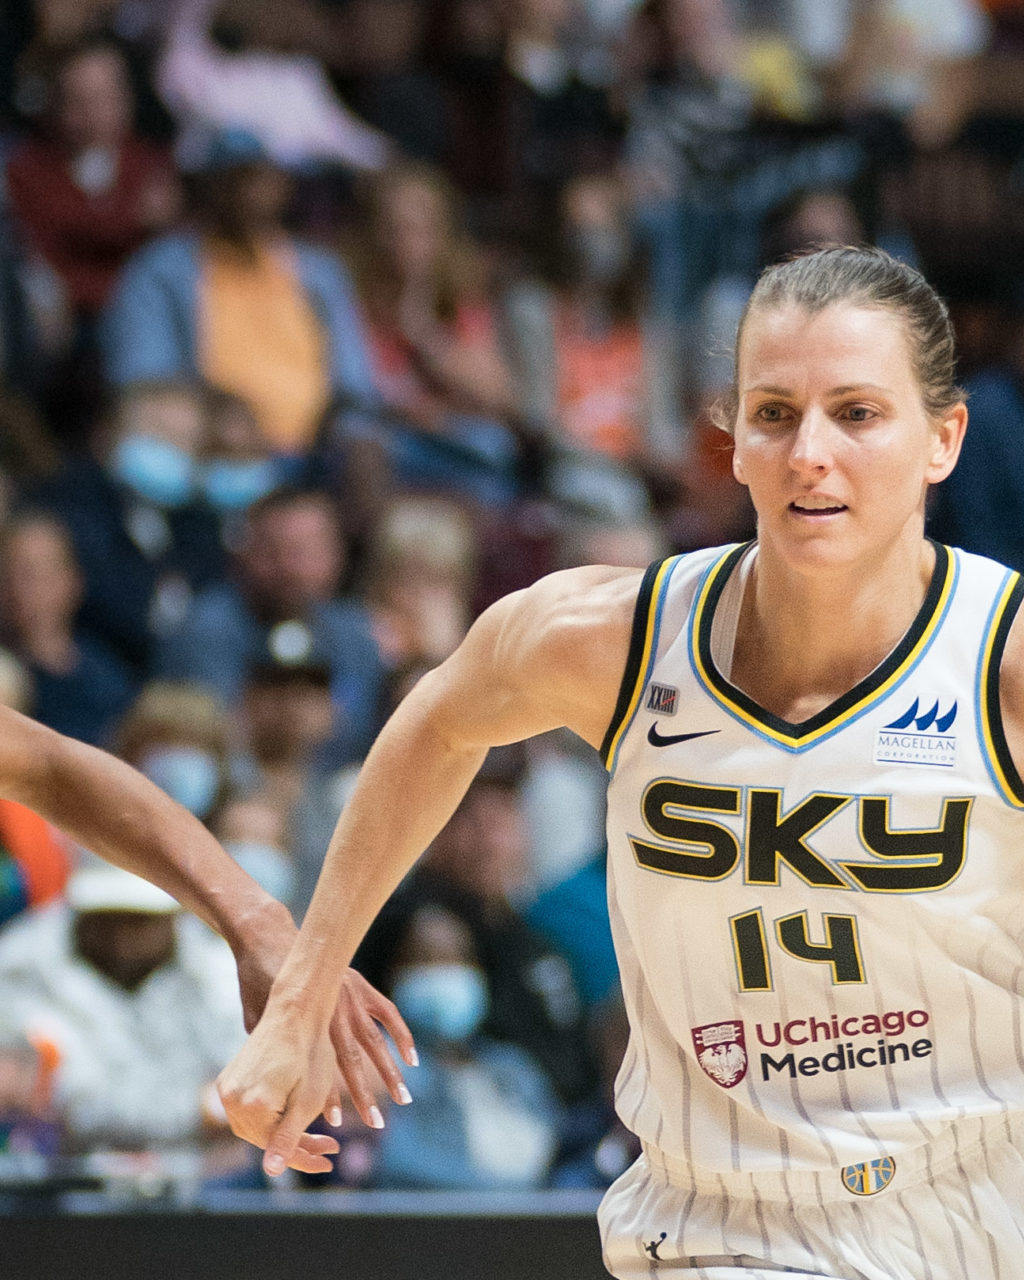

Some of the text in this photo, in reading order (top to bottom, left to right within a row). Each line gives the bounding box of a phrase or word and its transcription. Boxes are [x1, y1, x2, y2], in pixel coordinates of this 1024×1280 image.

[876, 750, 955, 761] CORPORATION
[878, 735, 957, 751] MAGELLAN
[627, 777, 976, 894] SKY
[728, 906, 867, 993] 14
[755, 1009, 930, 1047] UChicago
[760, 1038, 933, 1082] Medicine
